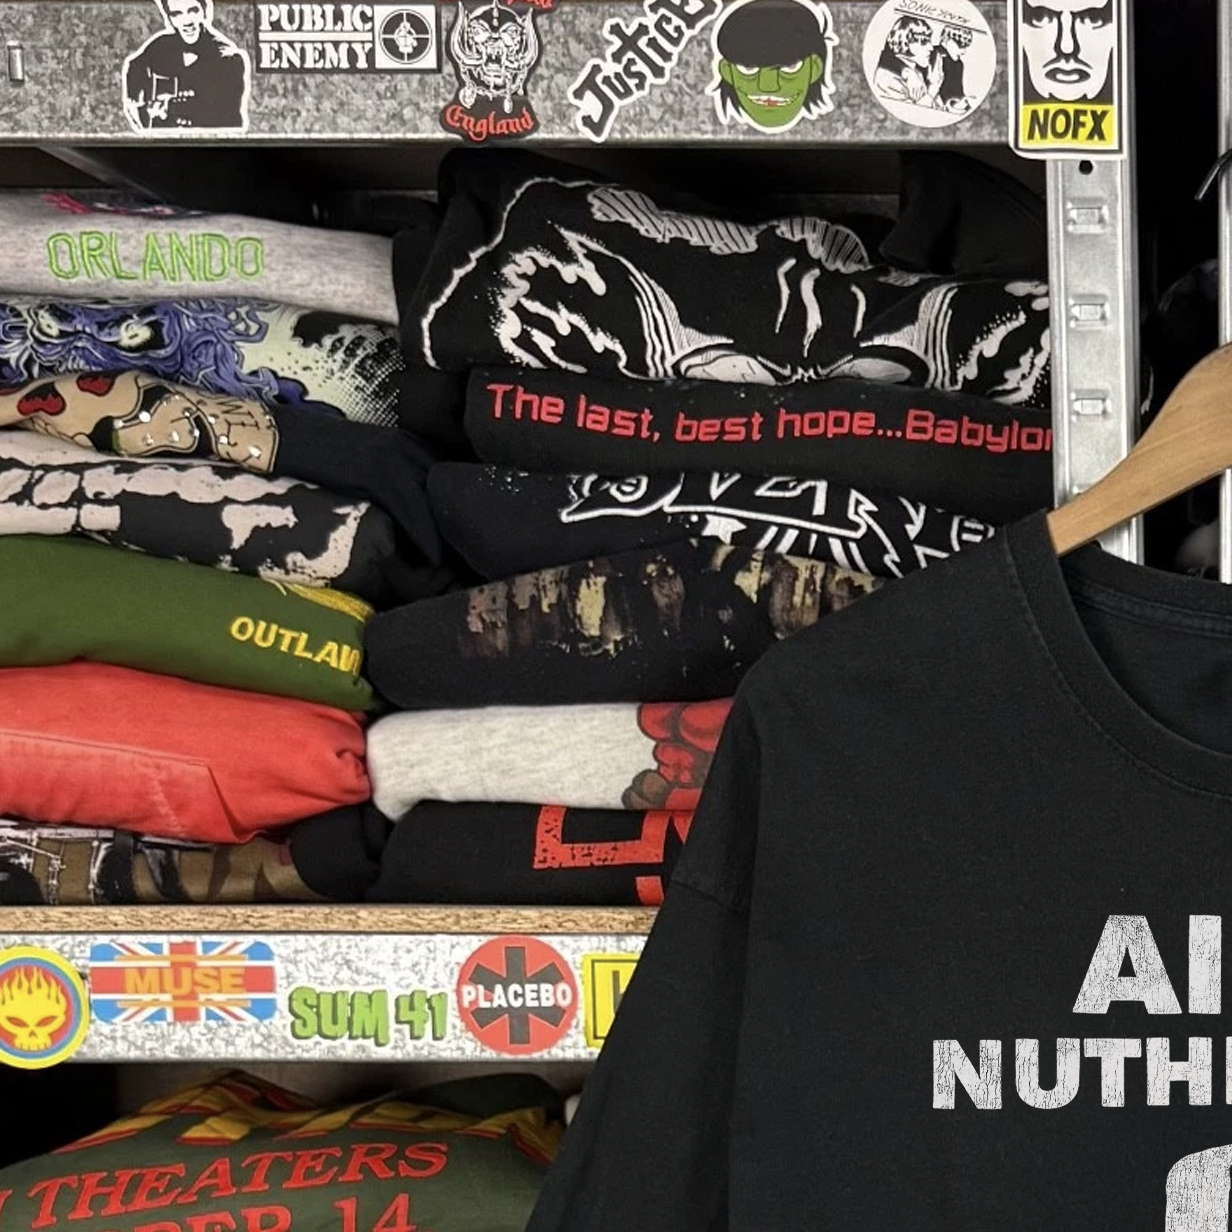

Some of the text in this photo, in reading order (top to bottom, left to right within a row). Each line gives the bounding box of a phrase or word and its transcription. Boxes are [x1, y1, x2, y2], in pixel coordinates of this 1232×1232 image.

[258, 4, 373, 31] PUBLIC
[259, 42, 374, 69] ENEMY
[445, 104, 535, 141] England
[1026, 107, 1111, 141] NOFX
[47, 230, 264, 283] ORLANDO
[486, 383, 564, 423] The
[576, 393, 660, 443] last,
[674, 410, 764, 442] best
[125, 967, 246, 997] MUSE
[462, 982, 572, 1008] PLACEBO
[290, 987, 448, 1046] SUM 41
[29, 1143, 449, 1230] THEATERS
